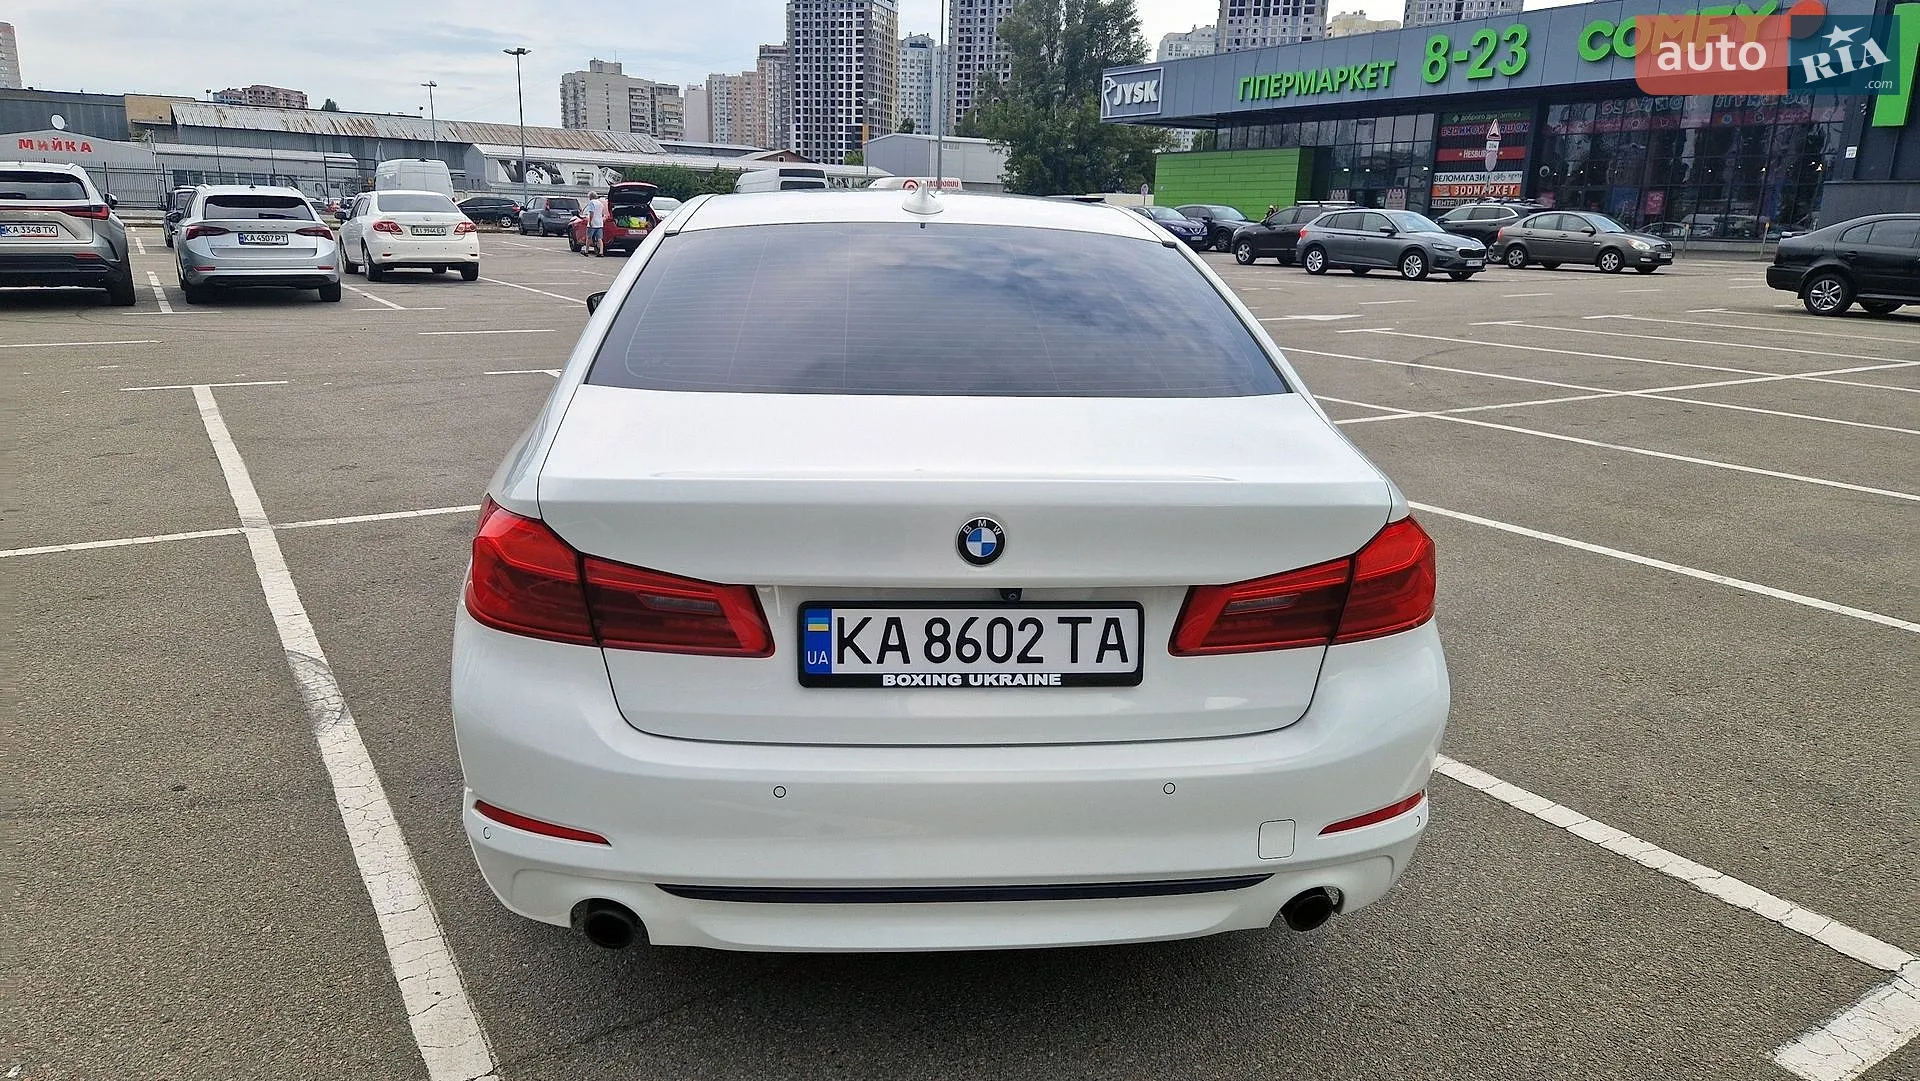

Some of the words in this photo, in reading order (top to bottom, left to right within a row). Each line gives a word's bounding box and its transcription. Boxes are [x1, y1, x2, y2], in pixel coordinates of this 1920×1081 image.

[1578, 0, 1778, 62] COMFY
[1422, 23, 1529, 84] 8-23
[1113, 79, 1159, 106] JYSK
[1238, 60, 1397, 101] ГІПЕРМАРКЕТ
[20, 226, 42, 234] 3348
[963, 519, 1003, 537] BMW
[836, 616, 911, 665] KA
[923, 616, 1045, 665] 8602
[1057, 616, 1129, 664] TA
[807, 650, 829, 665] UA
[883, 674, 962, 687] BOXING
[969, 673, 1062, 686] UKRAINE
